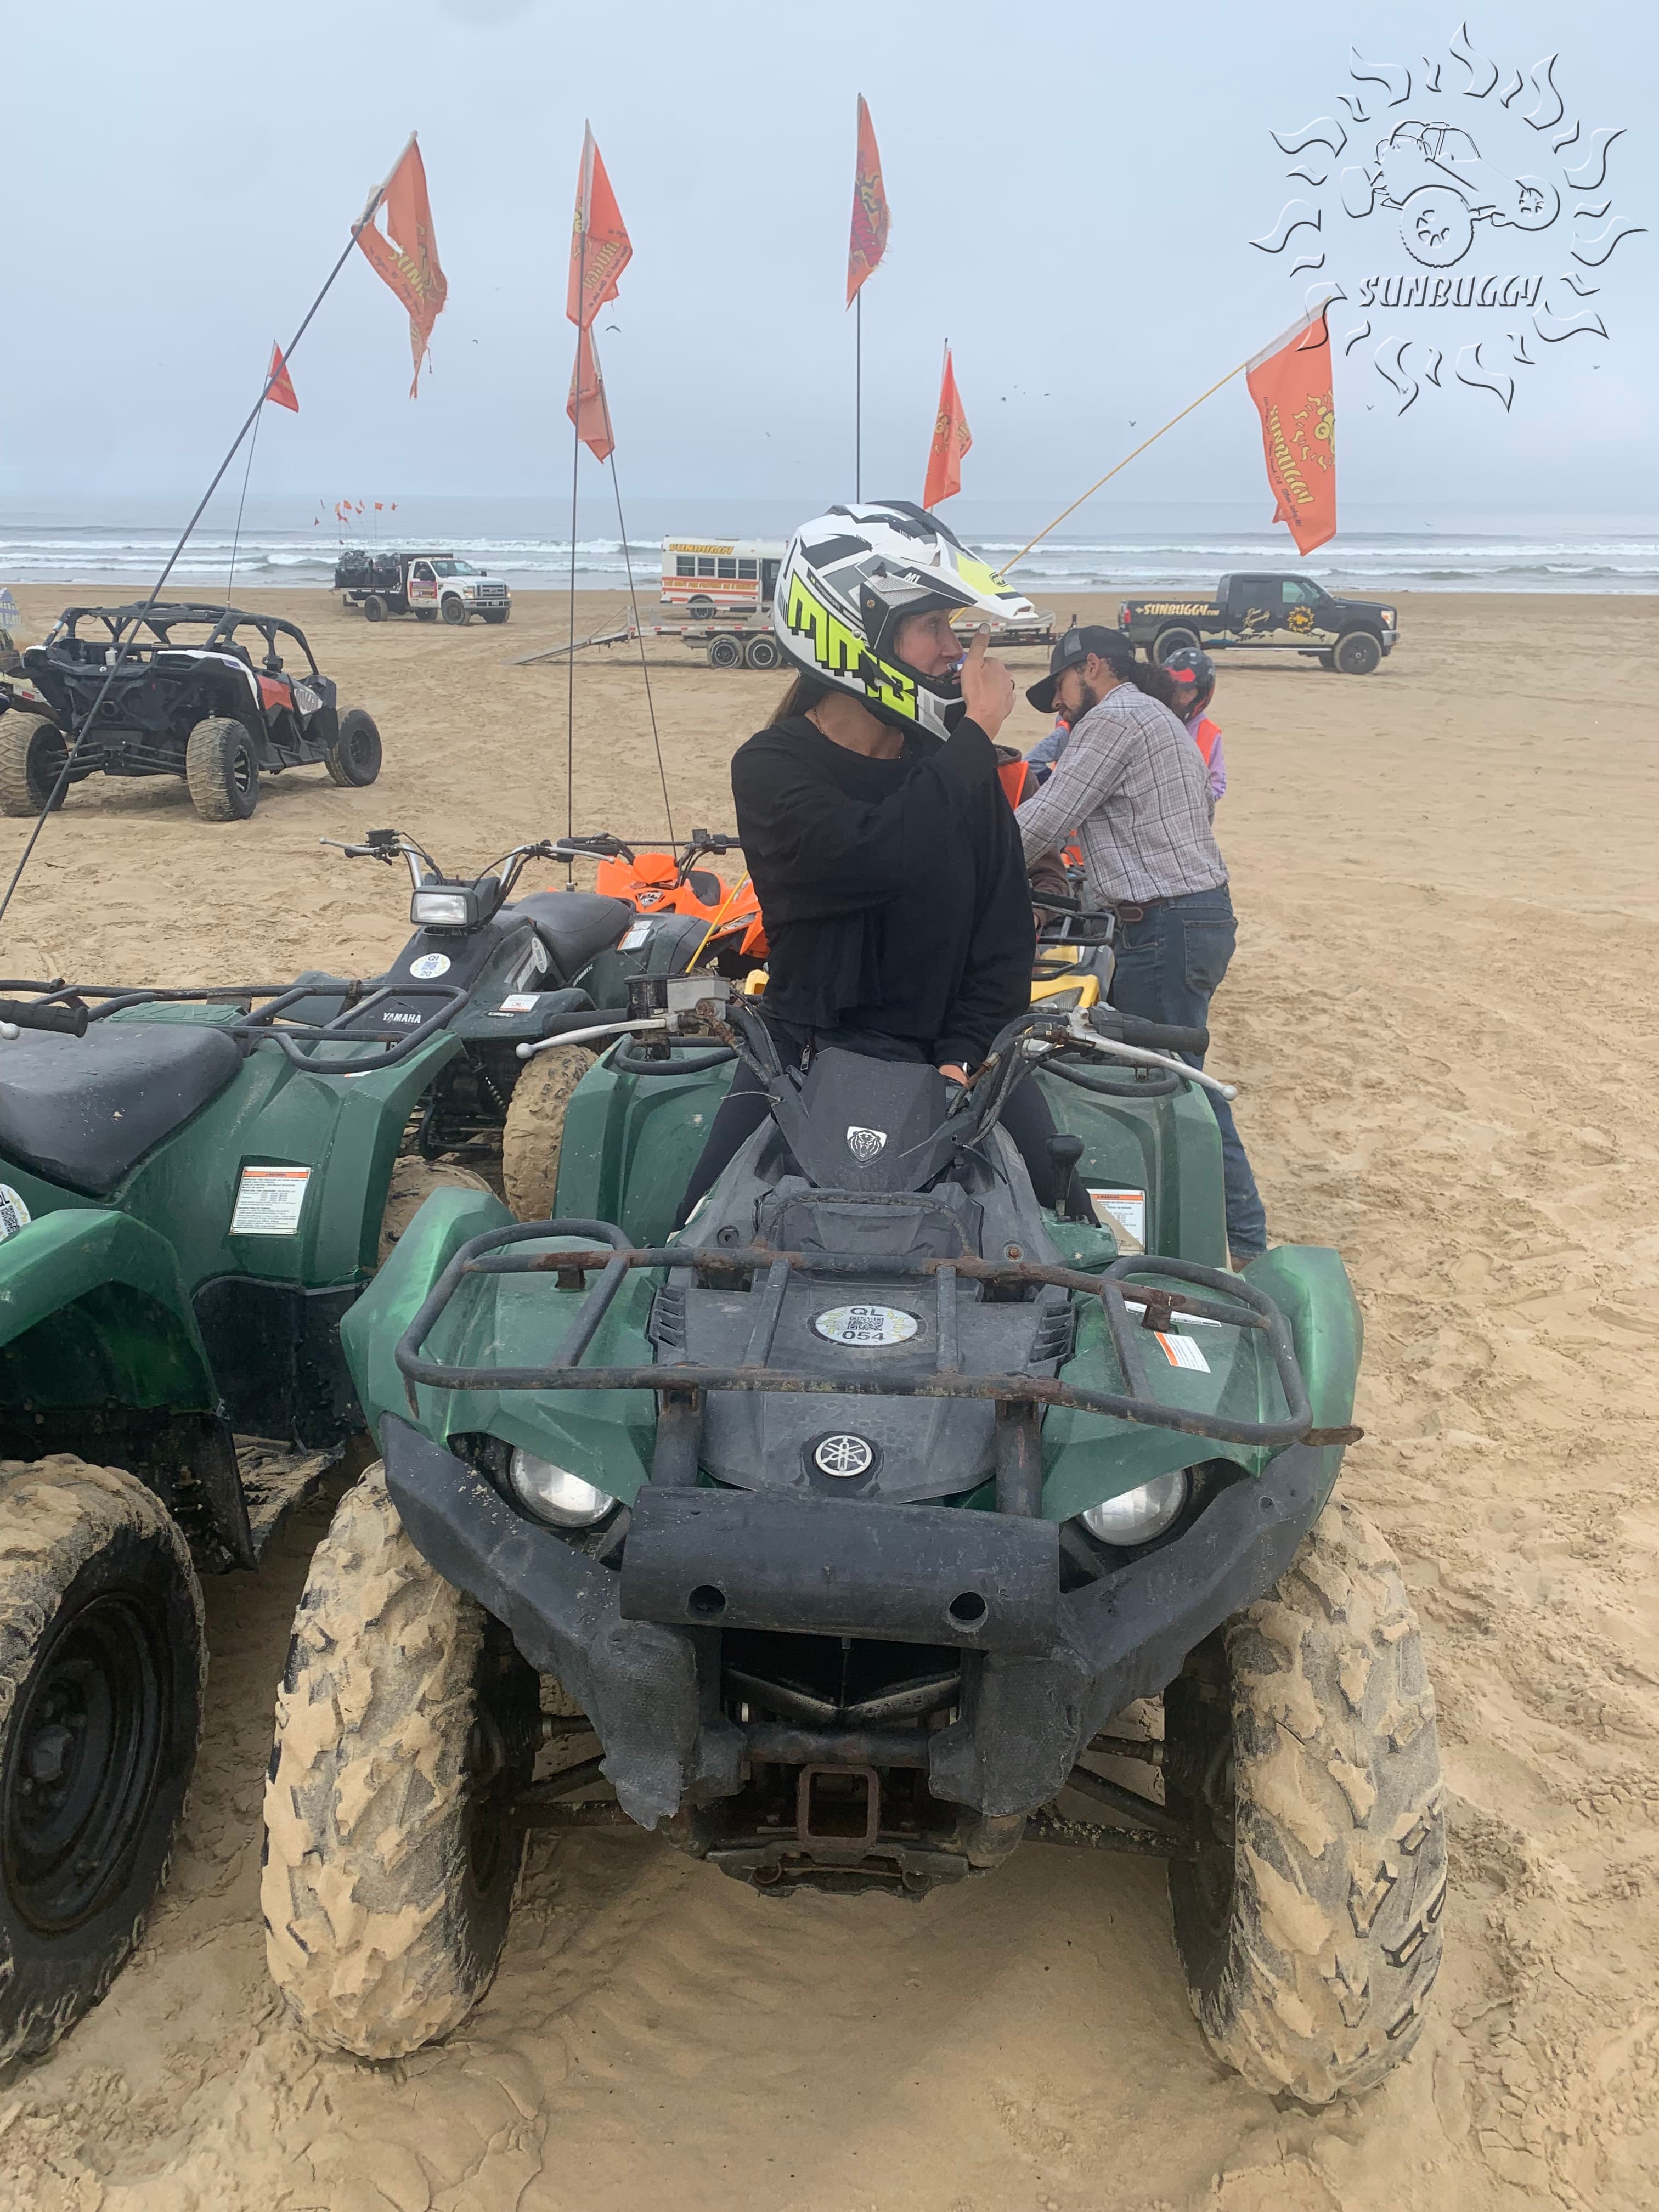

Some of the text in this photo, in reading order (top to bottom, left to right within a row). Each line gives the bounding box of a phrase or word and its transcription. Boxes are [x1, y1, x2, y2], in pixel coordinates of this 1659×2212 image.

[1270, 403, 1315, 504] SUNBUGGY
[382, 1013, 421, 1024] YAMAHA
[850, 1307, 884, 1317] QL
[842, 1331, 885, 1341] 054
